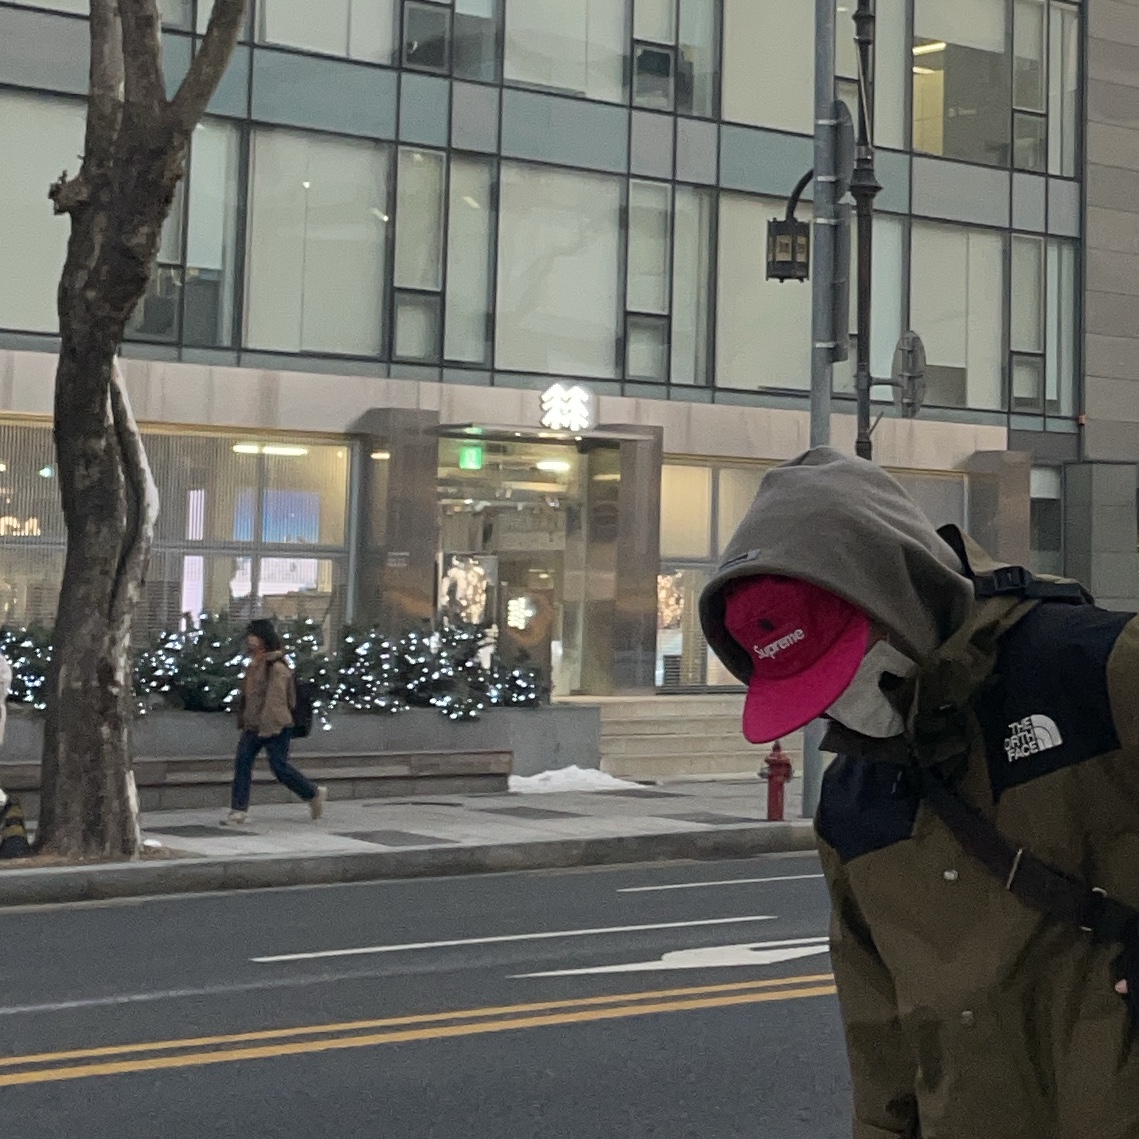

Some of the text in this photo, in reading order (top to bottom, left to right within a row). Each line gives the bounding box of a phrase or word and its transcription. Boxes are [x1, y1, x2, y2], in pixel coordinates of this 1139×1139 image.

[753, 629, 805, 659] Supreme
[1008, 716, 1033, 735] THE
[1004, 729, 1037, 751] ORTH
[1007, 741, 1039, 762] FACE
